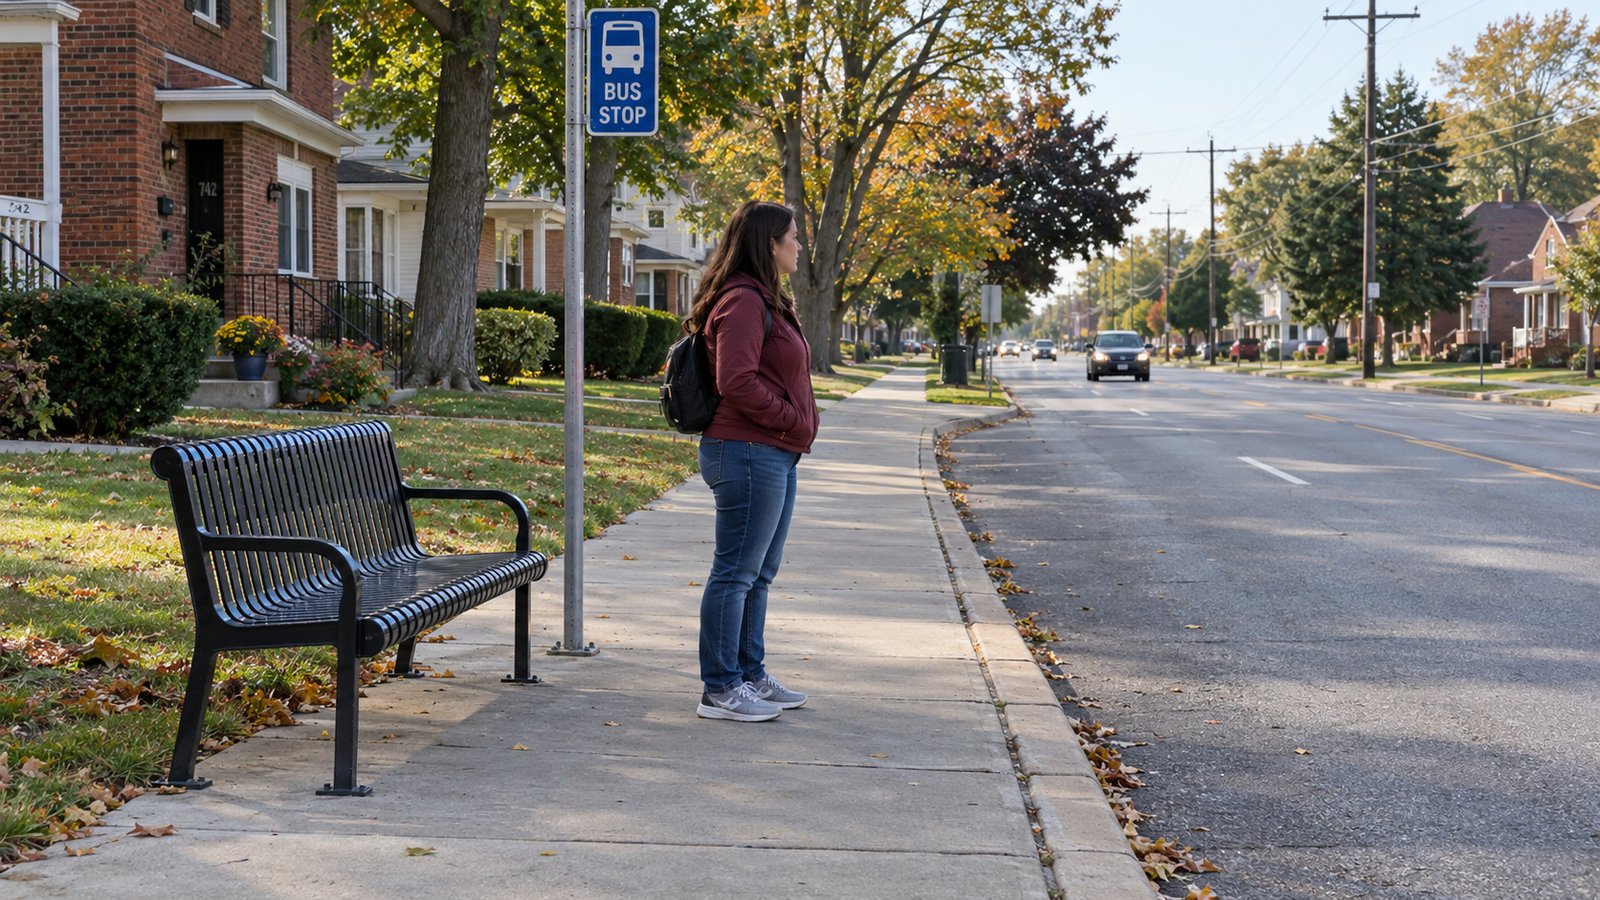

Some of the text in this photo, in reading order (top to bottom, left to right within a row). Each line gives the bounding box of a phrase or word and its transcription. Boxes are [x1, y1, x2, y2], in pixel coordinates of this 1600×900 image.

[604, 82, 641, 100] BUS
[599, 106, 646, 124] STOP
[198, 181, 217, 197] 742
